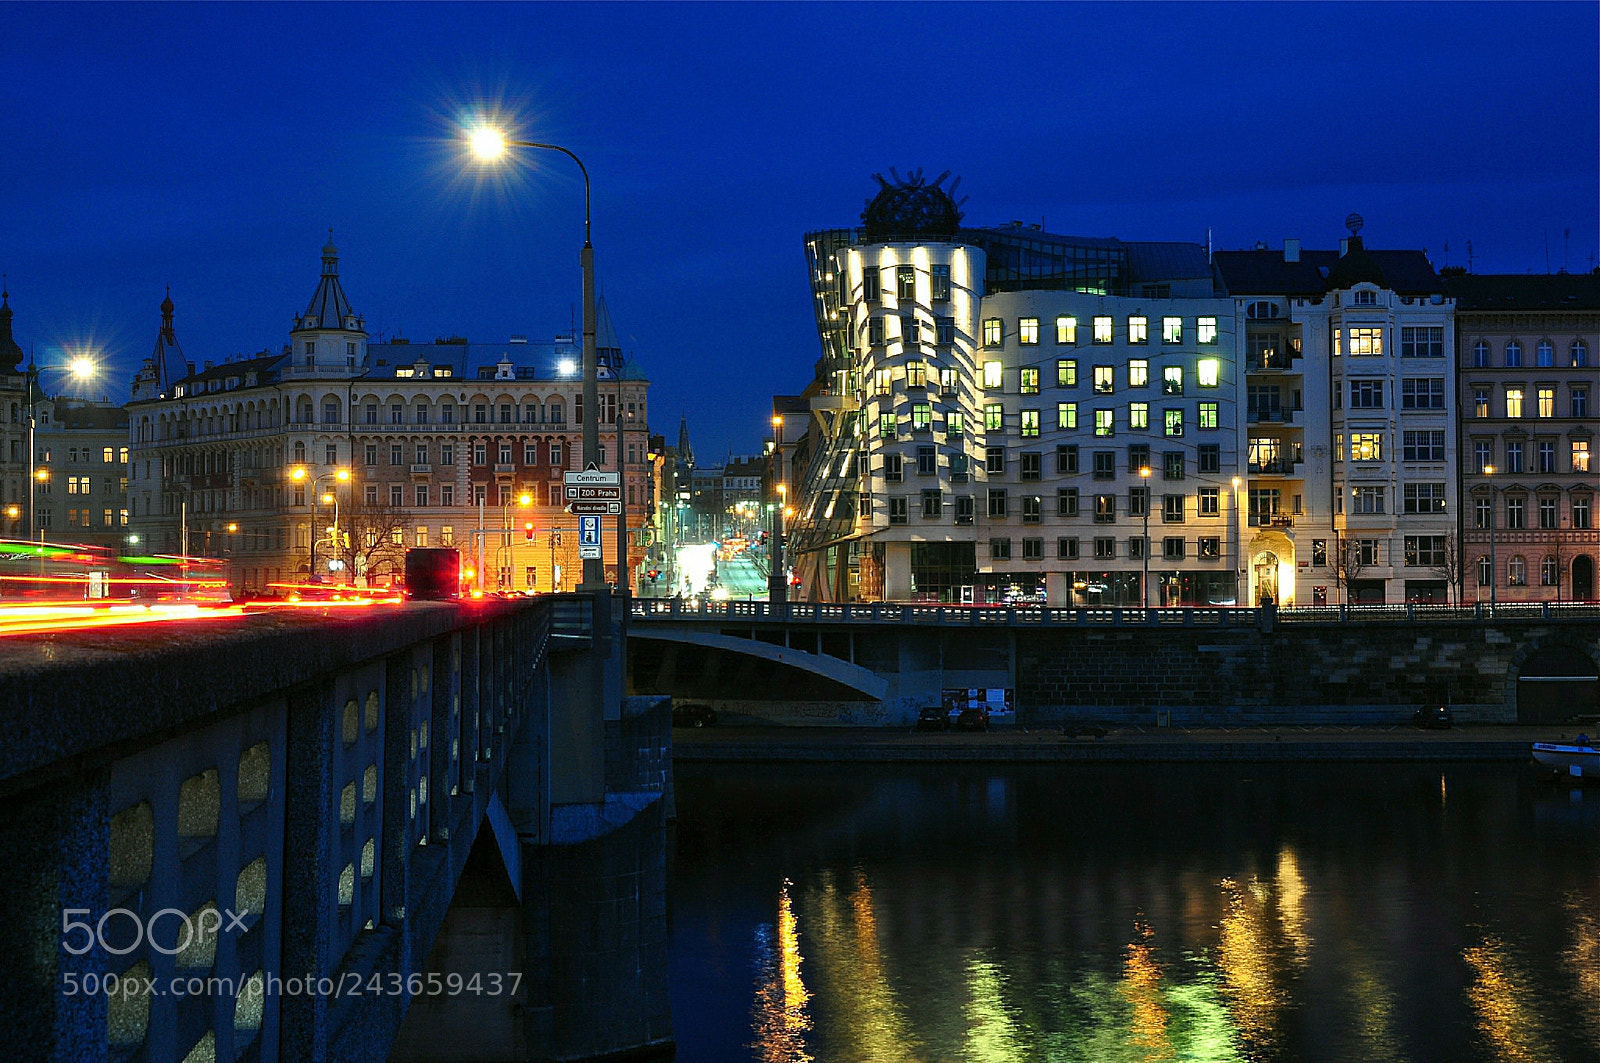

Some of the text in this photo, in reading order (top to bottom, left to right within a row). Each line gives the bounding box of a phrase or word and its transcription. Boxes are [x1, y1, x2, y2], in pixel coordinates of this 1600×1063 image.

[576, 474, 607, 482] Centrum
[581, 489, 617, 497] ZOO Praha
